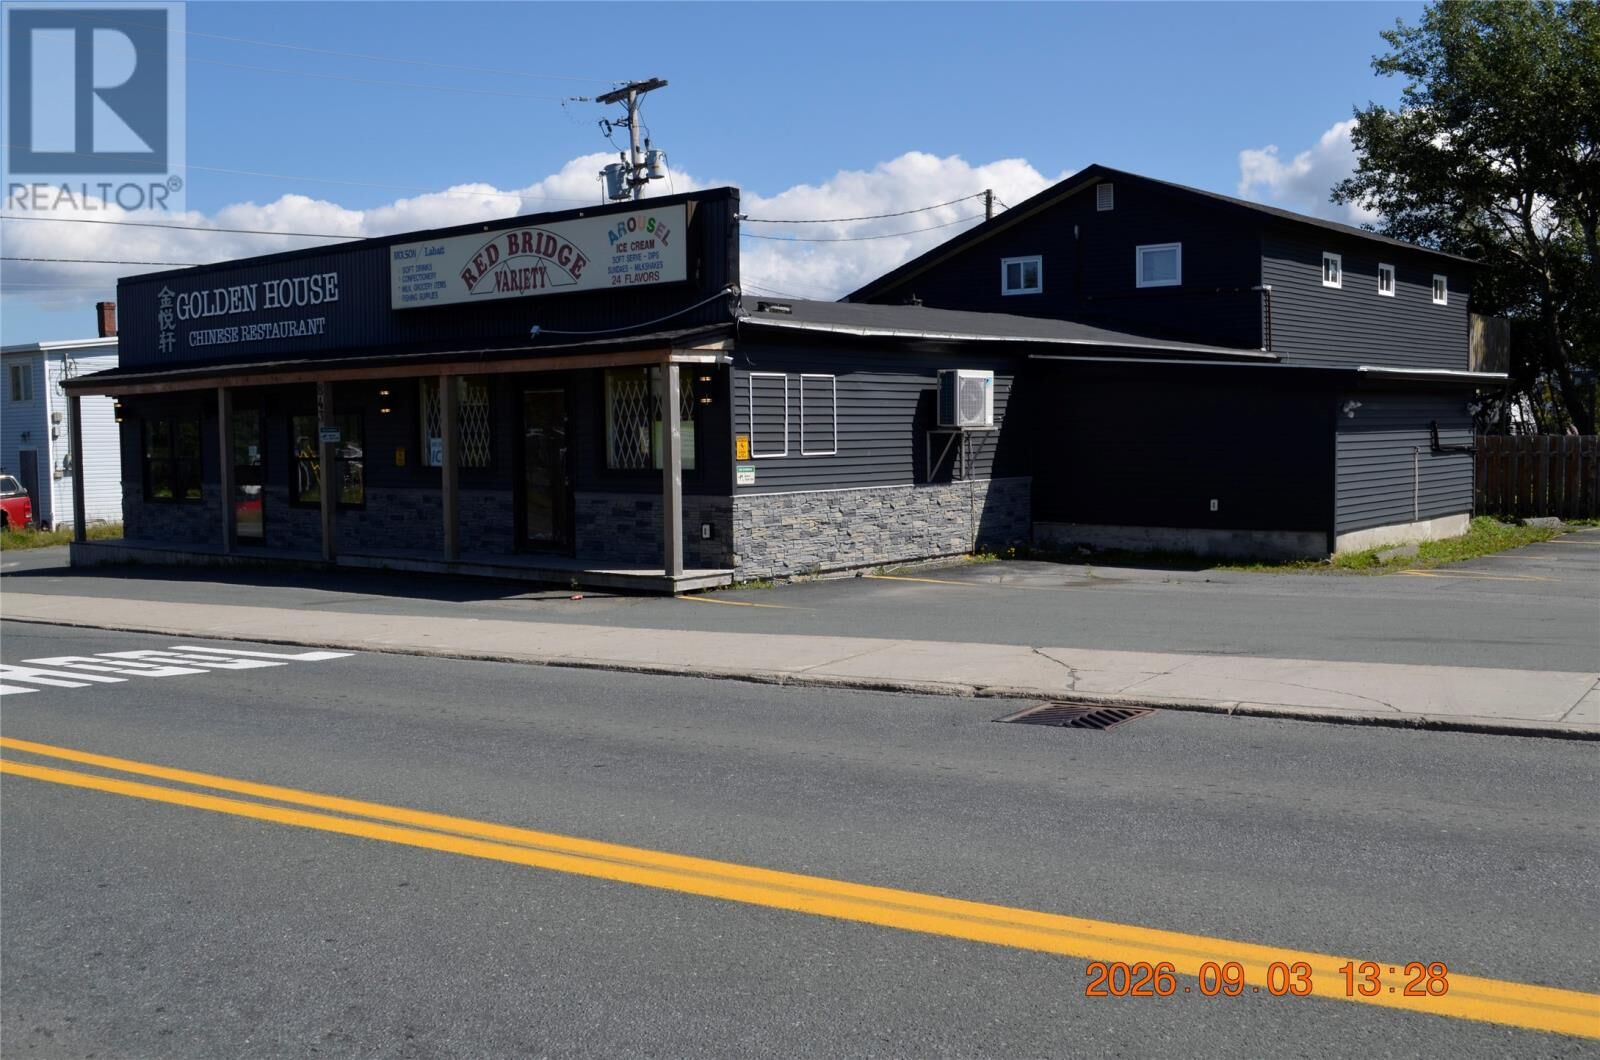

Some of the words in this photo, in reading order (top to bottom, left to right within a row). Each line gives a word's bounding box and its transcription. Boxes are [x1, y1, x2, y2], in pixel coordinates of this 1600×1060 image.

[608, 215, 671, 247] AROUSEL
[612, 255, 625, 264] SOFT
[626, 253, 642, 263] SERVE
[616, 243, 627, 254] ICE
[630, 239, 656, 252] CREAM
[461, 243, 500, 291] RED
[506, 231, 587, 280] BRIDGE
[634, 261, 663, 271] MILKSHAKES
[495, 266, 547, 293] VARIETY
[612, 275, 621, 286] 24
[624, 271, 660, 284] FLAVORS
[176, 283, 257, 320] GOLDEN
[263, 272, 339, 309] HOUSE
[189, 326, 239, 347] CHINESE
[240, 317, 326, 341] RESTAURANT
